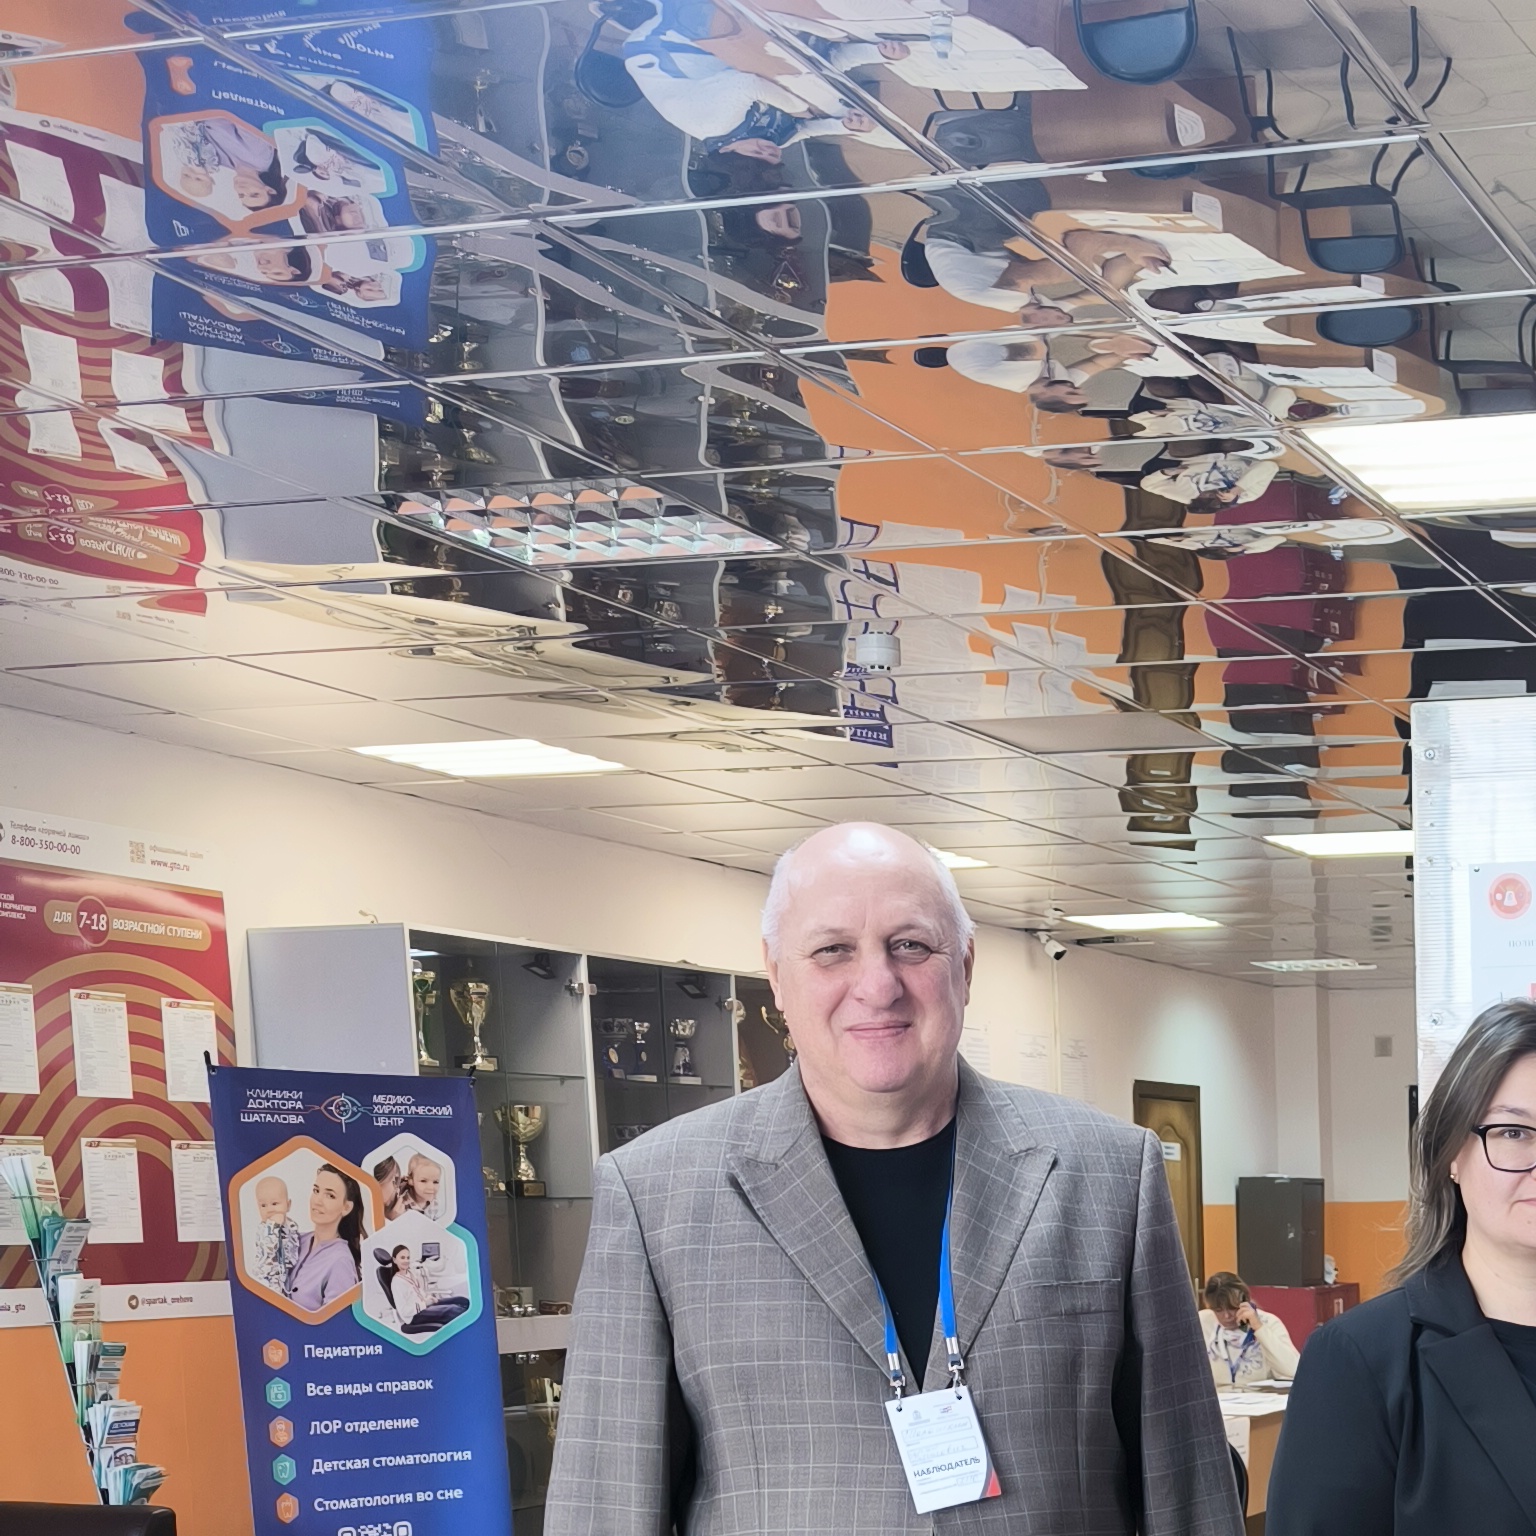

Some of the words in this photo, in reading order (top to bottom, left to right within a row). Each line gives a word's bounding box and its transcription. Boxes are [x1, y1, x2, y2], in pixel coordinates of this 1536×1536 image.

[11, 834, 81, 855] 8-800-350-00-00
[53, 910, 72, 924] ДЛЯ
[78, 911, 108, 932] 7-18
[112, 917, 166, 936] ВОЗРАСТНОЙ
[166, 925, 203, 940] СТУПЕНИ
[246, 1088, 303, 1100] КЛИНИКИ
[372, 1094, 415, 1104] МЕДИКО-
[247, 1099, 304, 1111] ДОКТОРА
[372, 1103, 453, 1115] ХИРУРГИЧЕСКИЙ
[240, 1113, 305, 1124] ШАТАЛОВА
[373, 1116, 404, 1127] ЦЕНТР
[304, 1343, 383, 1359] Педиатрия
[306, 1383, 333, 1396] Все
[335, 1382, 373, 1396] виды
[376, 1379, 434, 1395] справок
[309, 1420, 342, 1435] ЛОР
[344, 1417, 420, 1433] отделение
[311, 1458, 370, 1475] Детская
[373, 1450, 472, 1468] стоматология
[913, 1456, 981, 1478] НАБЛЮДАТЕЛЬ
[314, 1491, 413, 1511] Стоматология
[416, 1491, 433, 1502] во
[437, 1488, 464, 1500] сне
